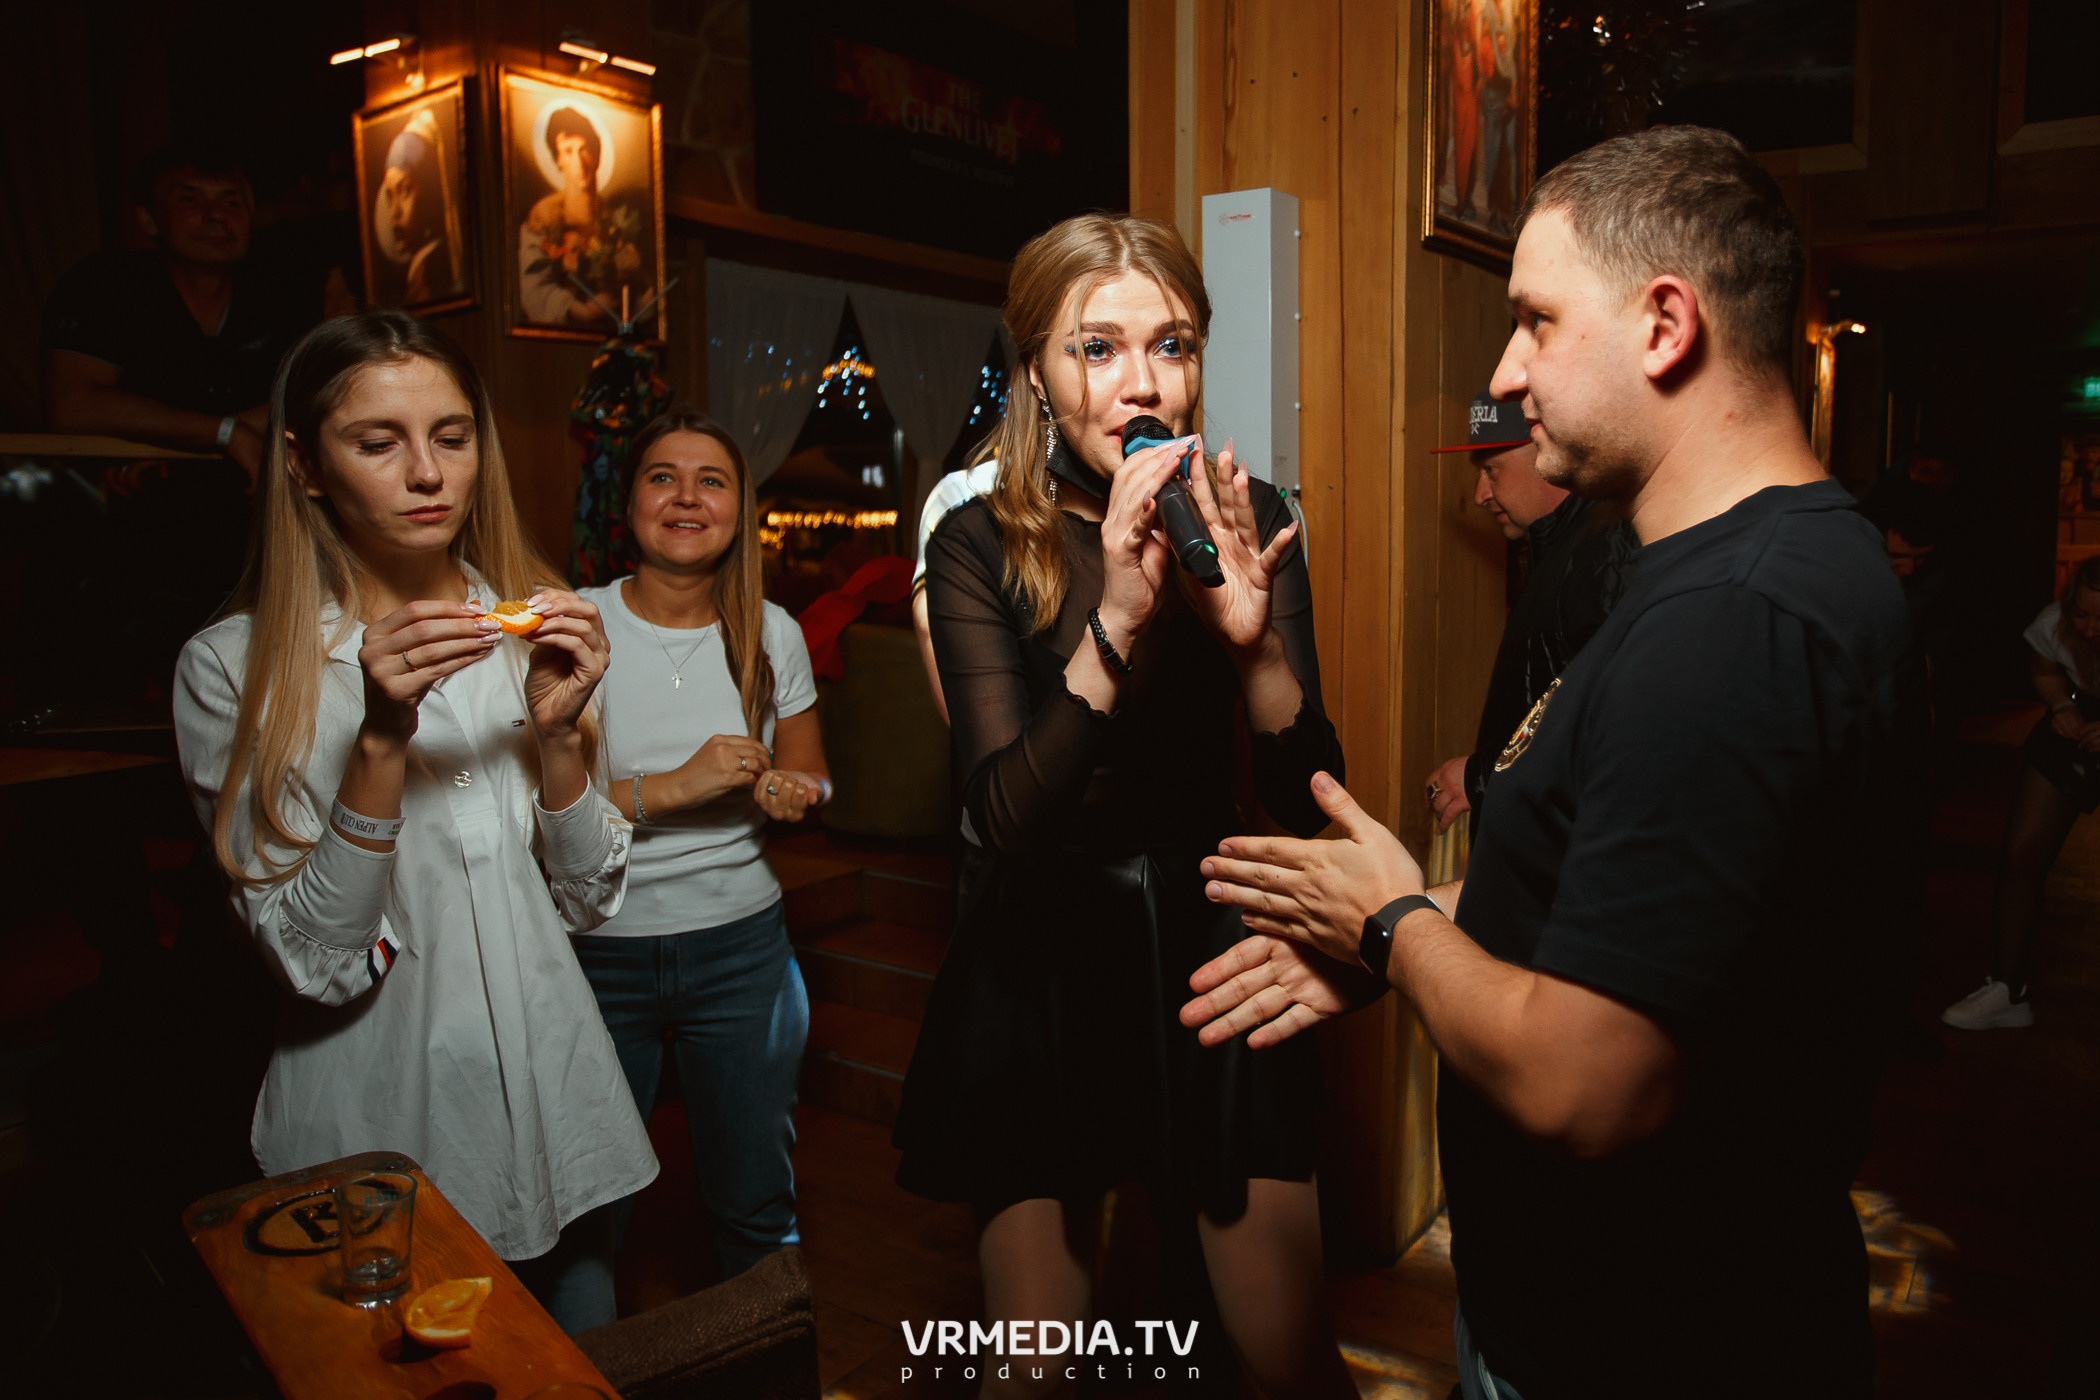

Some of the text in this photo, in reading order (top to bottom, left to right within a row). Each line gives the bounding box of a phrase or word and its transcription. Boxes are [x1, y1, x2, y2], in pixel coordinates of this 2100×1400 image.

[949, 80, 984, 114] THE
[902, 96, 1023, 167] GLENLIVET
[355, 819, 379, 836] ALPEN
